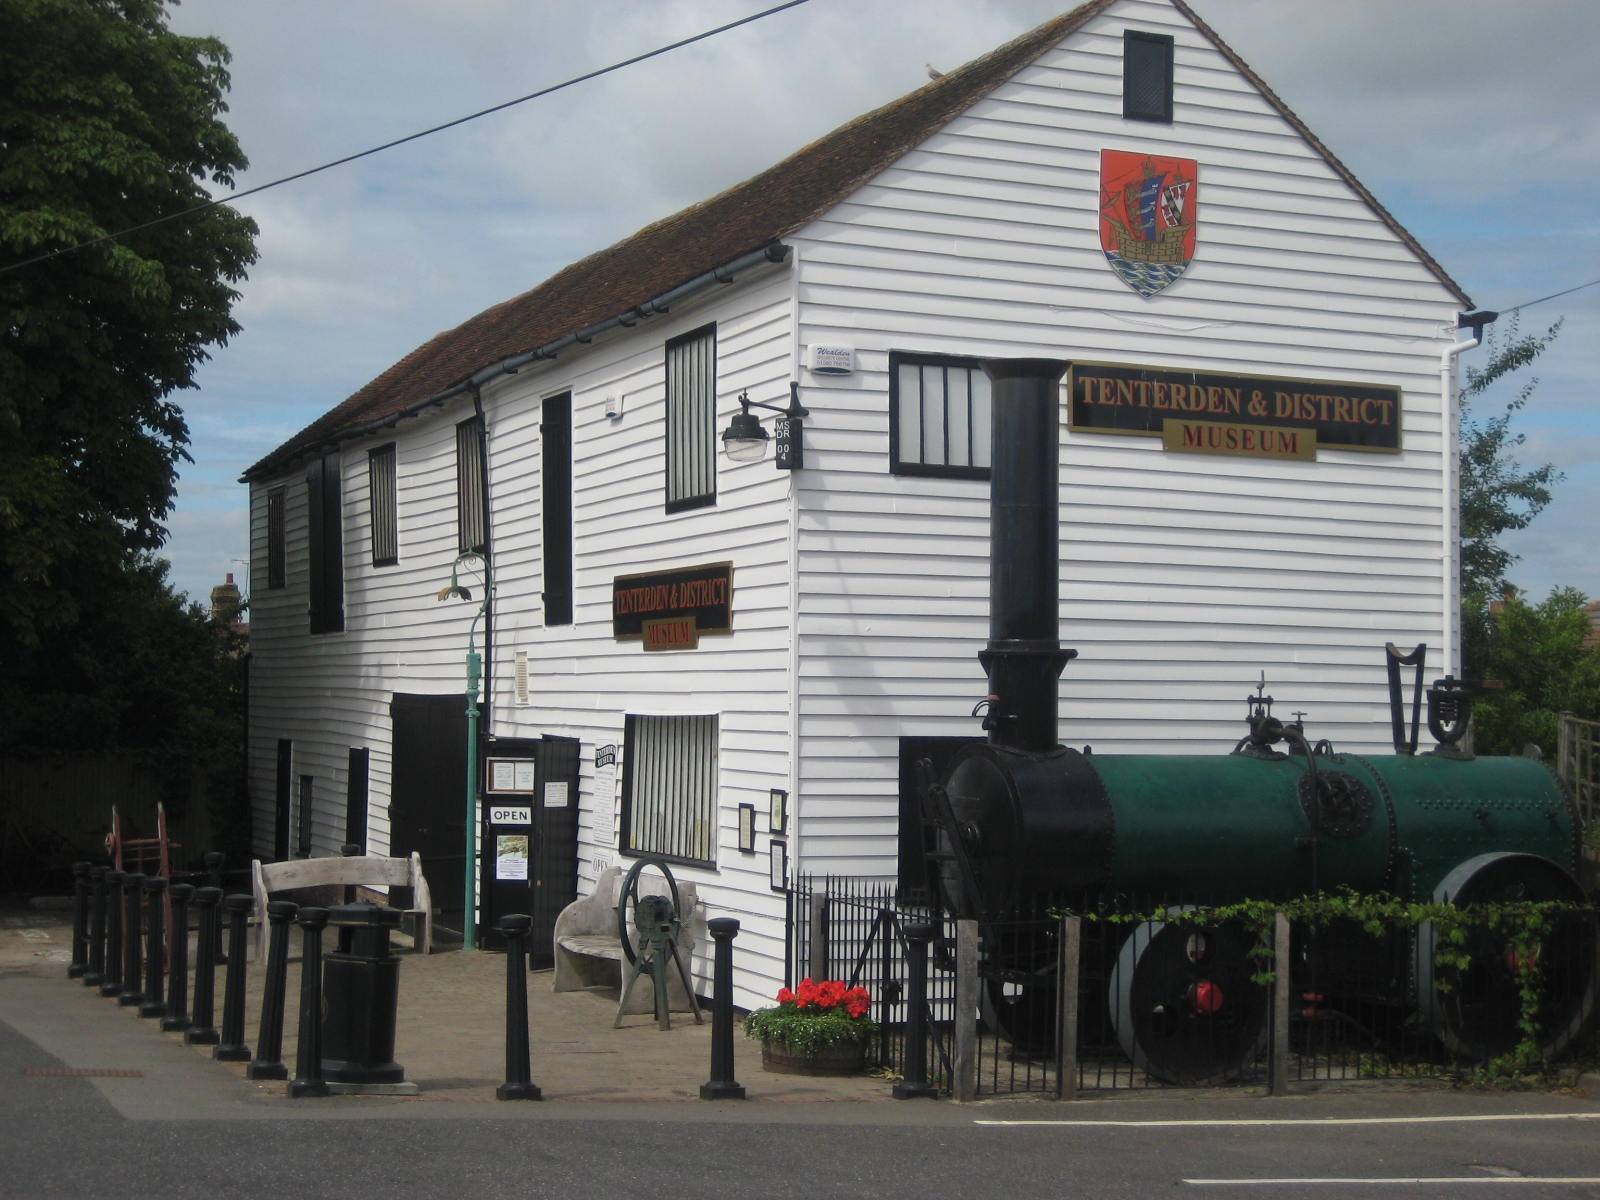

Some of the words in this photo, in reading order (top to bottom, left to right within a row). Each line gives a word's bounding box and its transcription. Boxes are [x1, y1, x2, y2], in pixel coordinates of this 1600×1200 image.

[1078, 376, 1242, 416] TENTERDEN
[1247, 389, 1268, 417] &
[1273, 391, 1394, 425] DISTRICT
[1182, 423, 1300, 454] MUSEUM
[615, 584, 669, 614] TENTERDEN
[670, 583, 679, 608] &
[680, 577, 727, 607] DISTRICT
[648, 622, 692, 645] MUSEUM
[494, 811, 528, 820] OPEN
